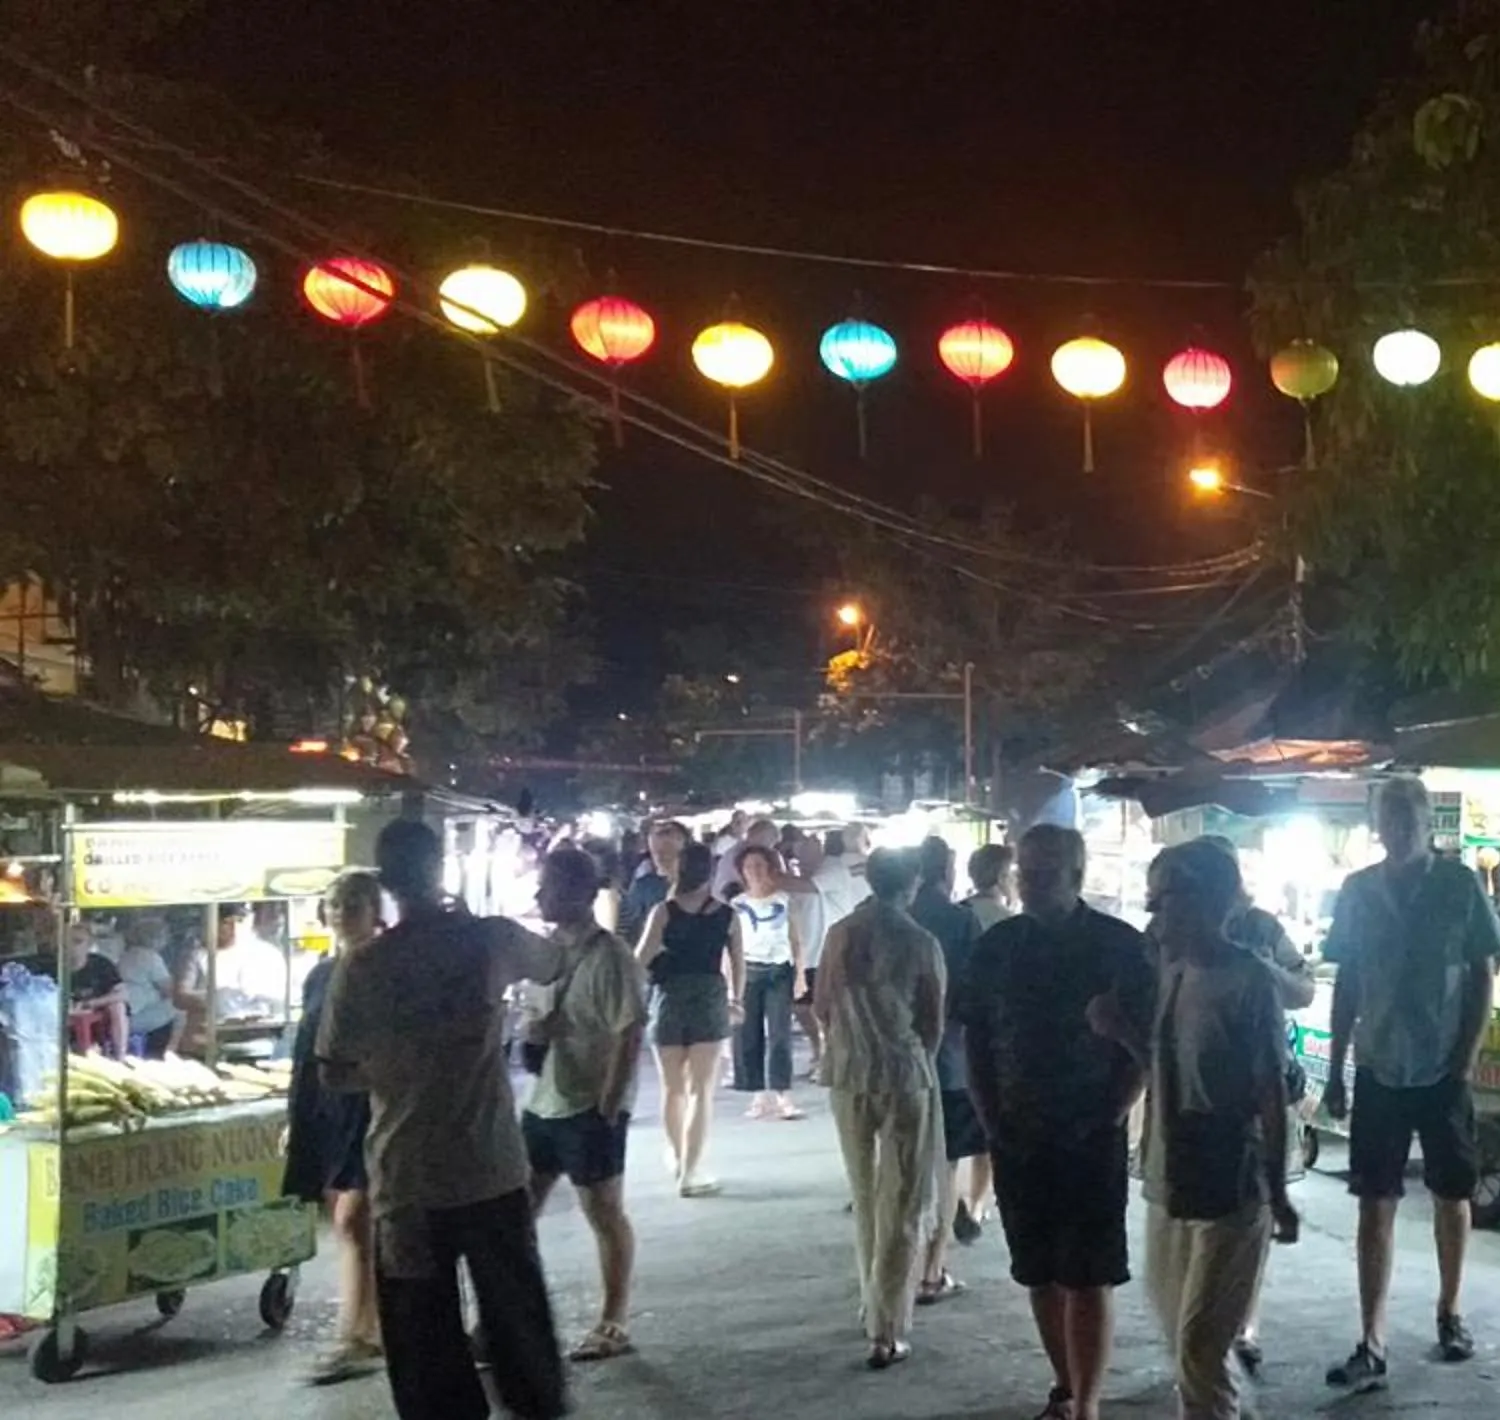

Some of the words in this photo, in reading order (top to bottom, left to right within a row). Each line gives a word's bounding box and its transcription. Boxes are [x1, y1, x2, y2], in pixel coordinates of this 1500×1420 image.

[83, 1192, 150, 1232] Baked
[157, 1186, 203, 1219] Rice
[210, 1174, 257, 1205] Cake
